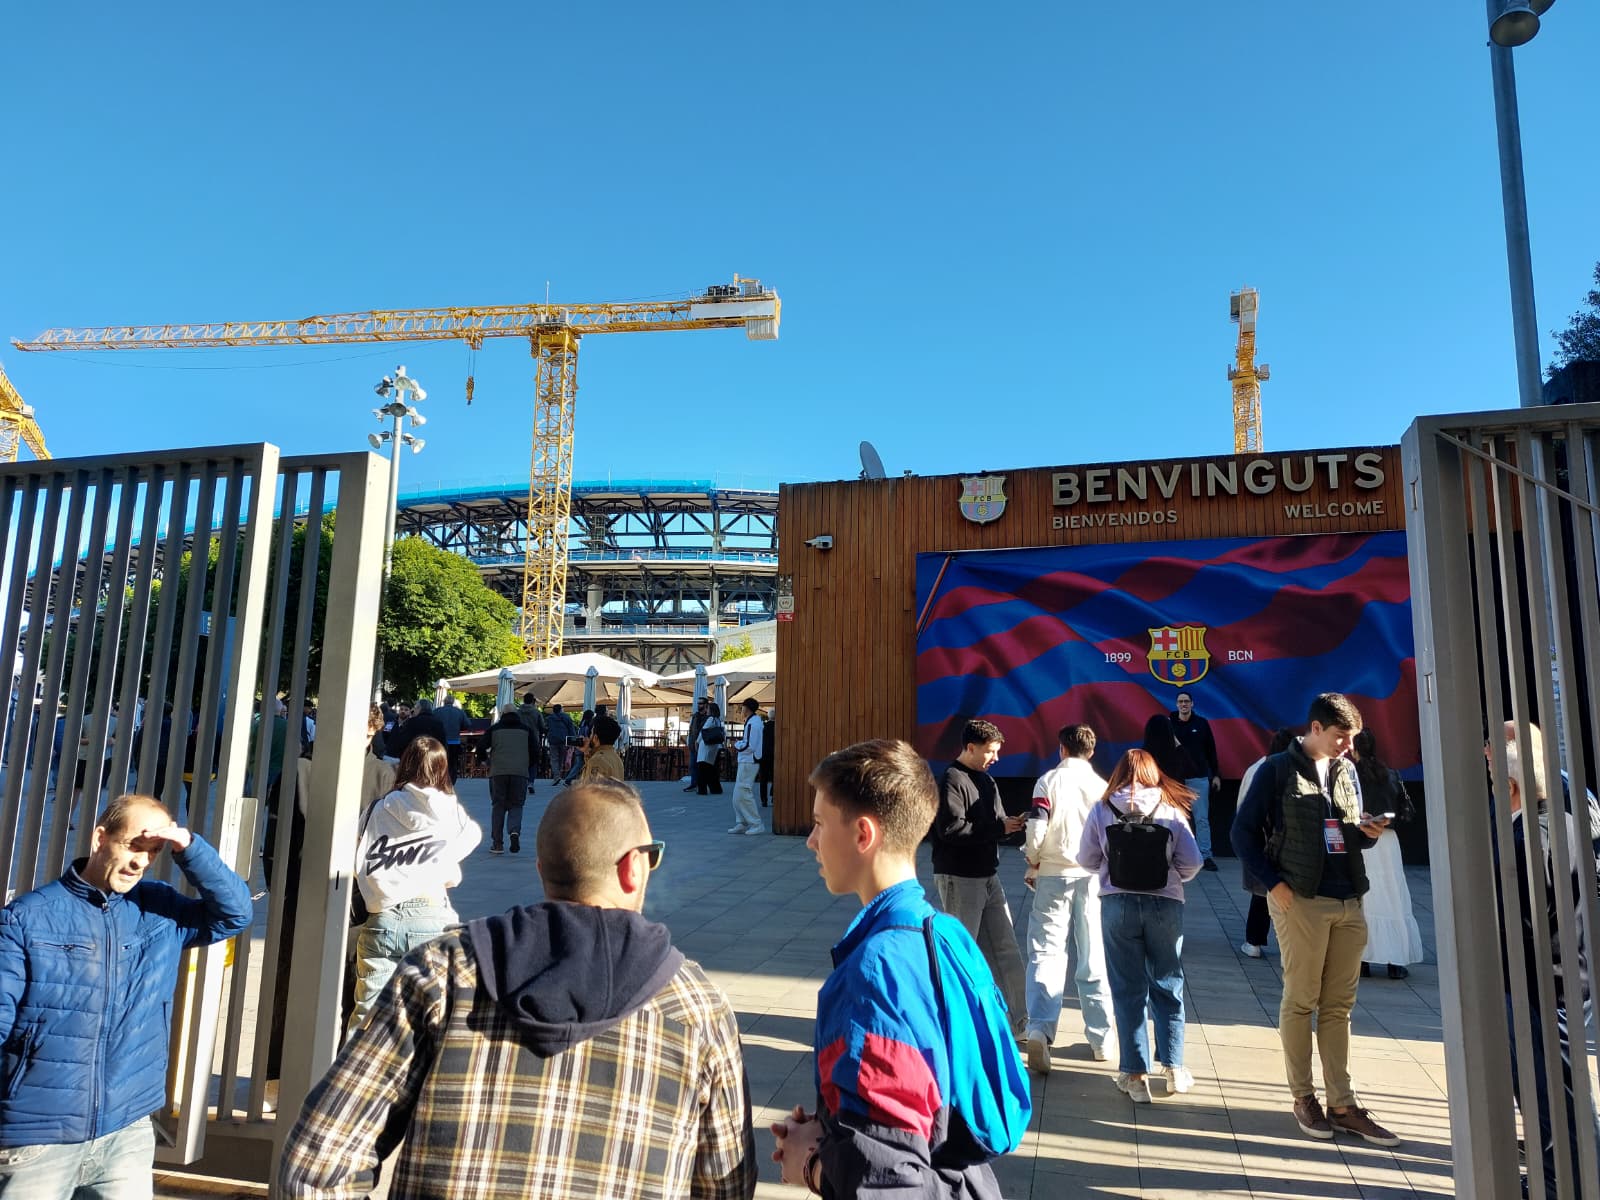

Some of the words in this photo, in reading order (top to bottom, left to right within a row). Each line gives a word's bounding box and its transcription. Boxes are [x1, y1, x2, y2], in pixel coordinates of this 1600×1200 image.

[1052, 453, 1385, 506] BENVINGUTS
[1284, 500, 1385, 518] WELCOME
[1052, 510, 1178, 530] BIENVENIDOS
[1104, 652, 1132, 663] 1899
[1228, 650, 1253, 661] BCN
